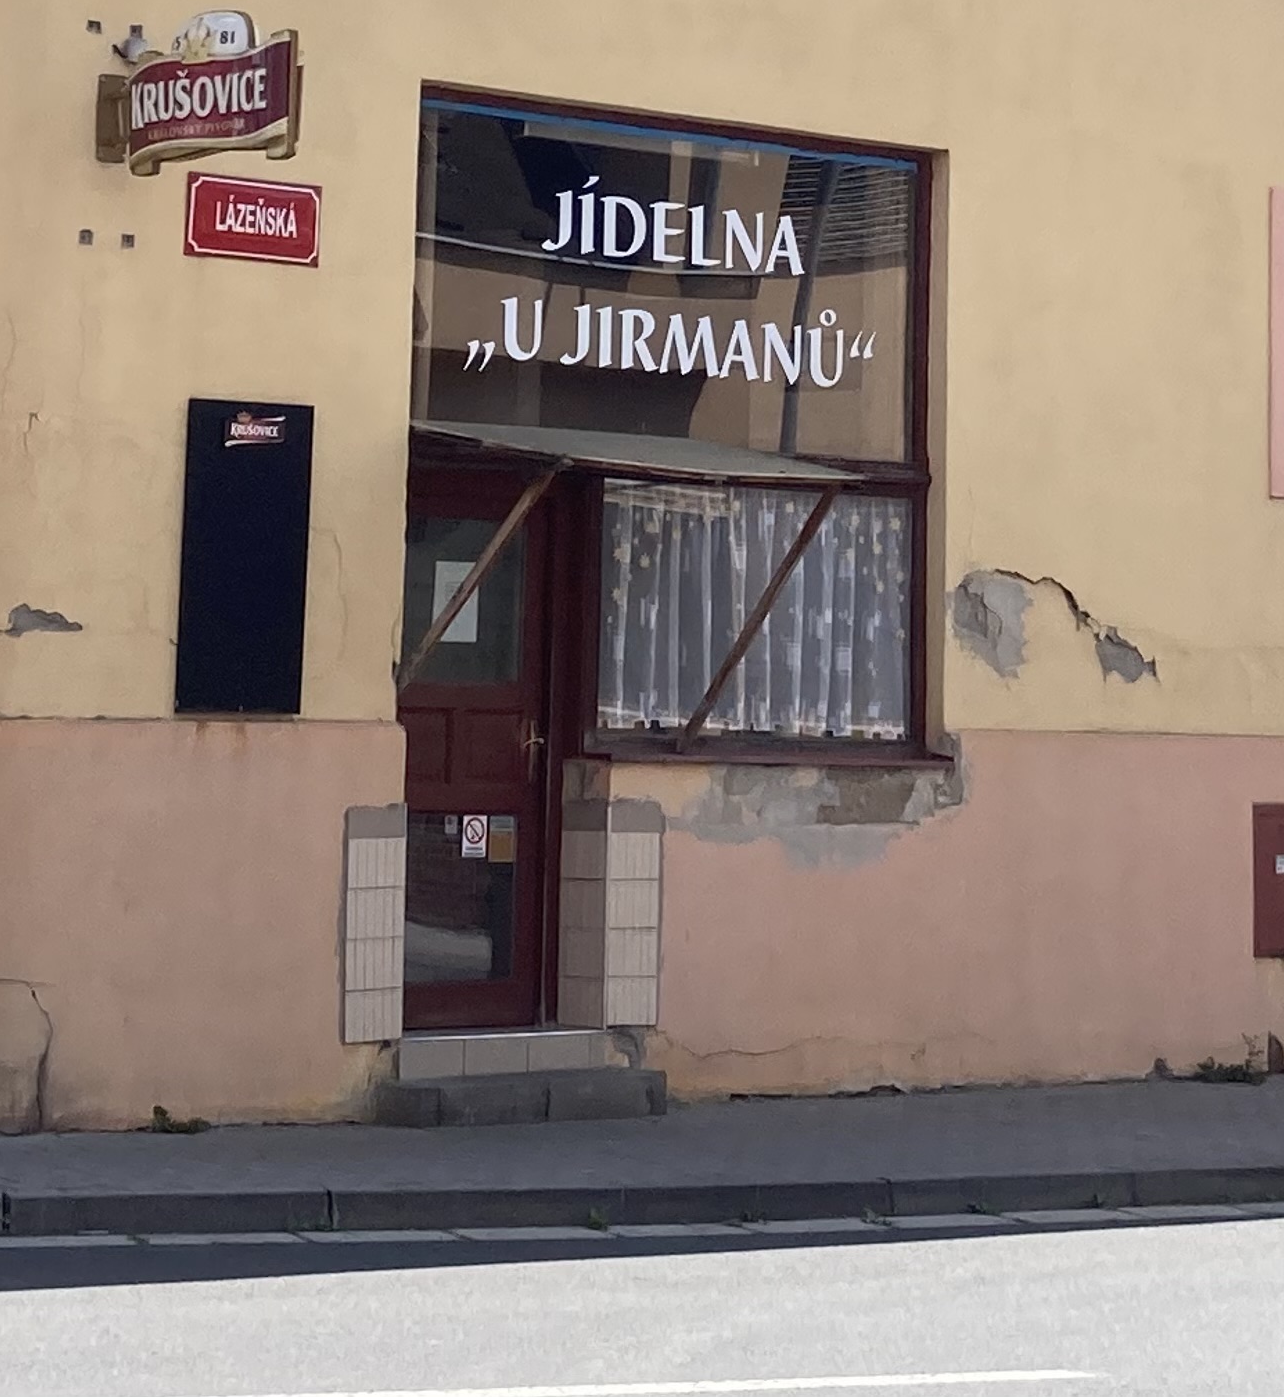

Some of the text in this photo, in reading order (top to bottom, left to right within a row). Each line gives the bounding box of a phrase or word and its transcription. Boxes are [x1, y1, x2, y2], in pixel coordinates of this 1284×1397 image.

[219, 30, 236, 45] 81
[131, 69, 267, 130] KRUŠOVICE
[215, 194, 297, 238] LÁZEŇSKÁ
[541, 176, 805, 276] JÍDELNA
